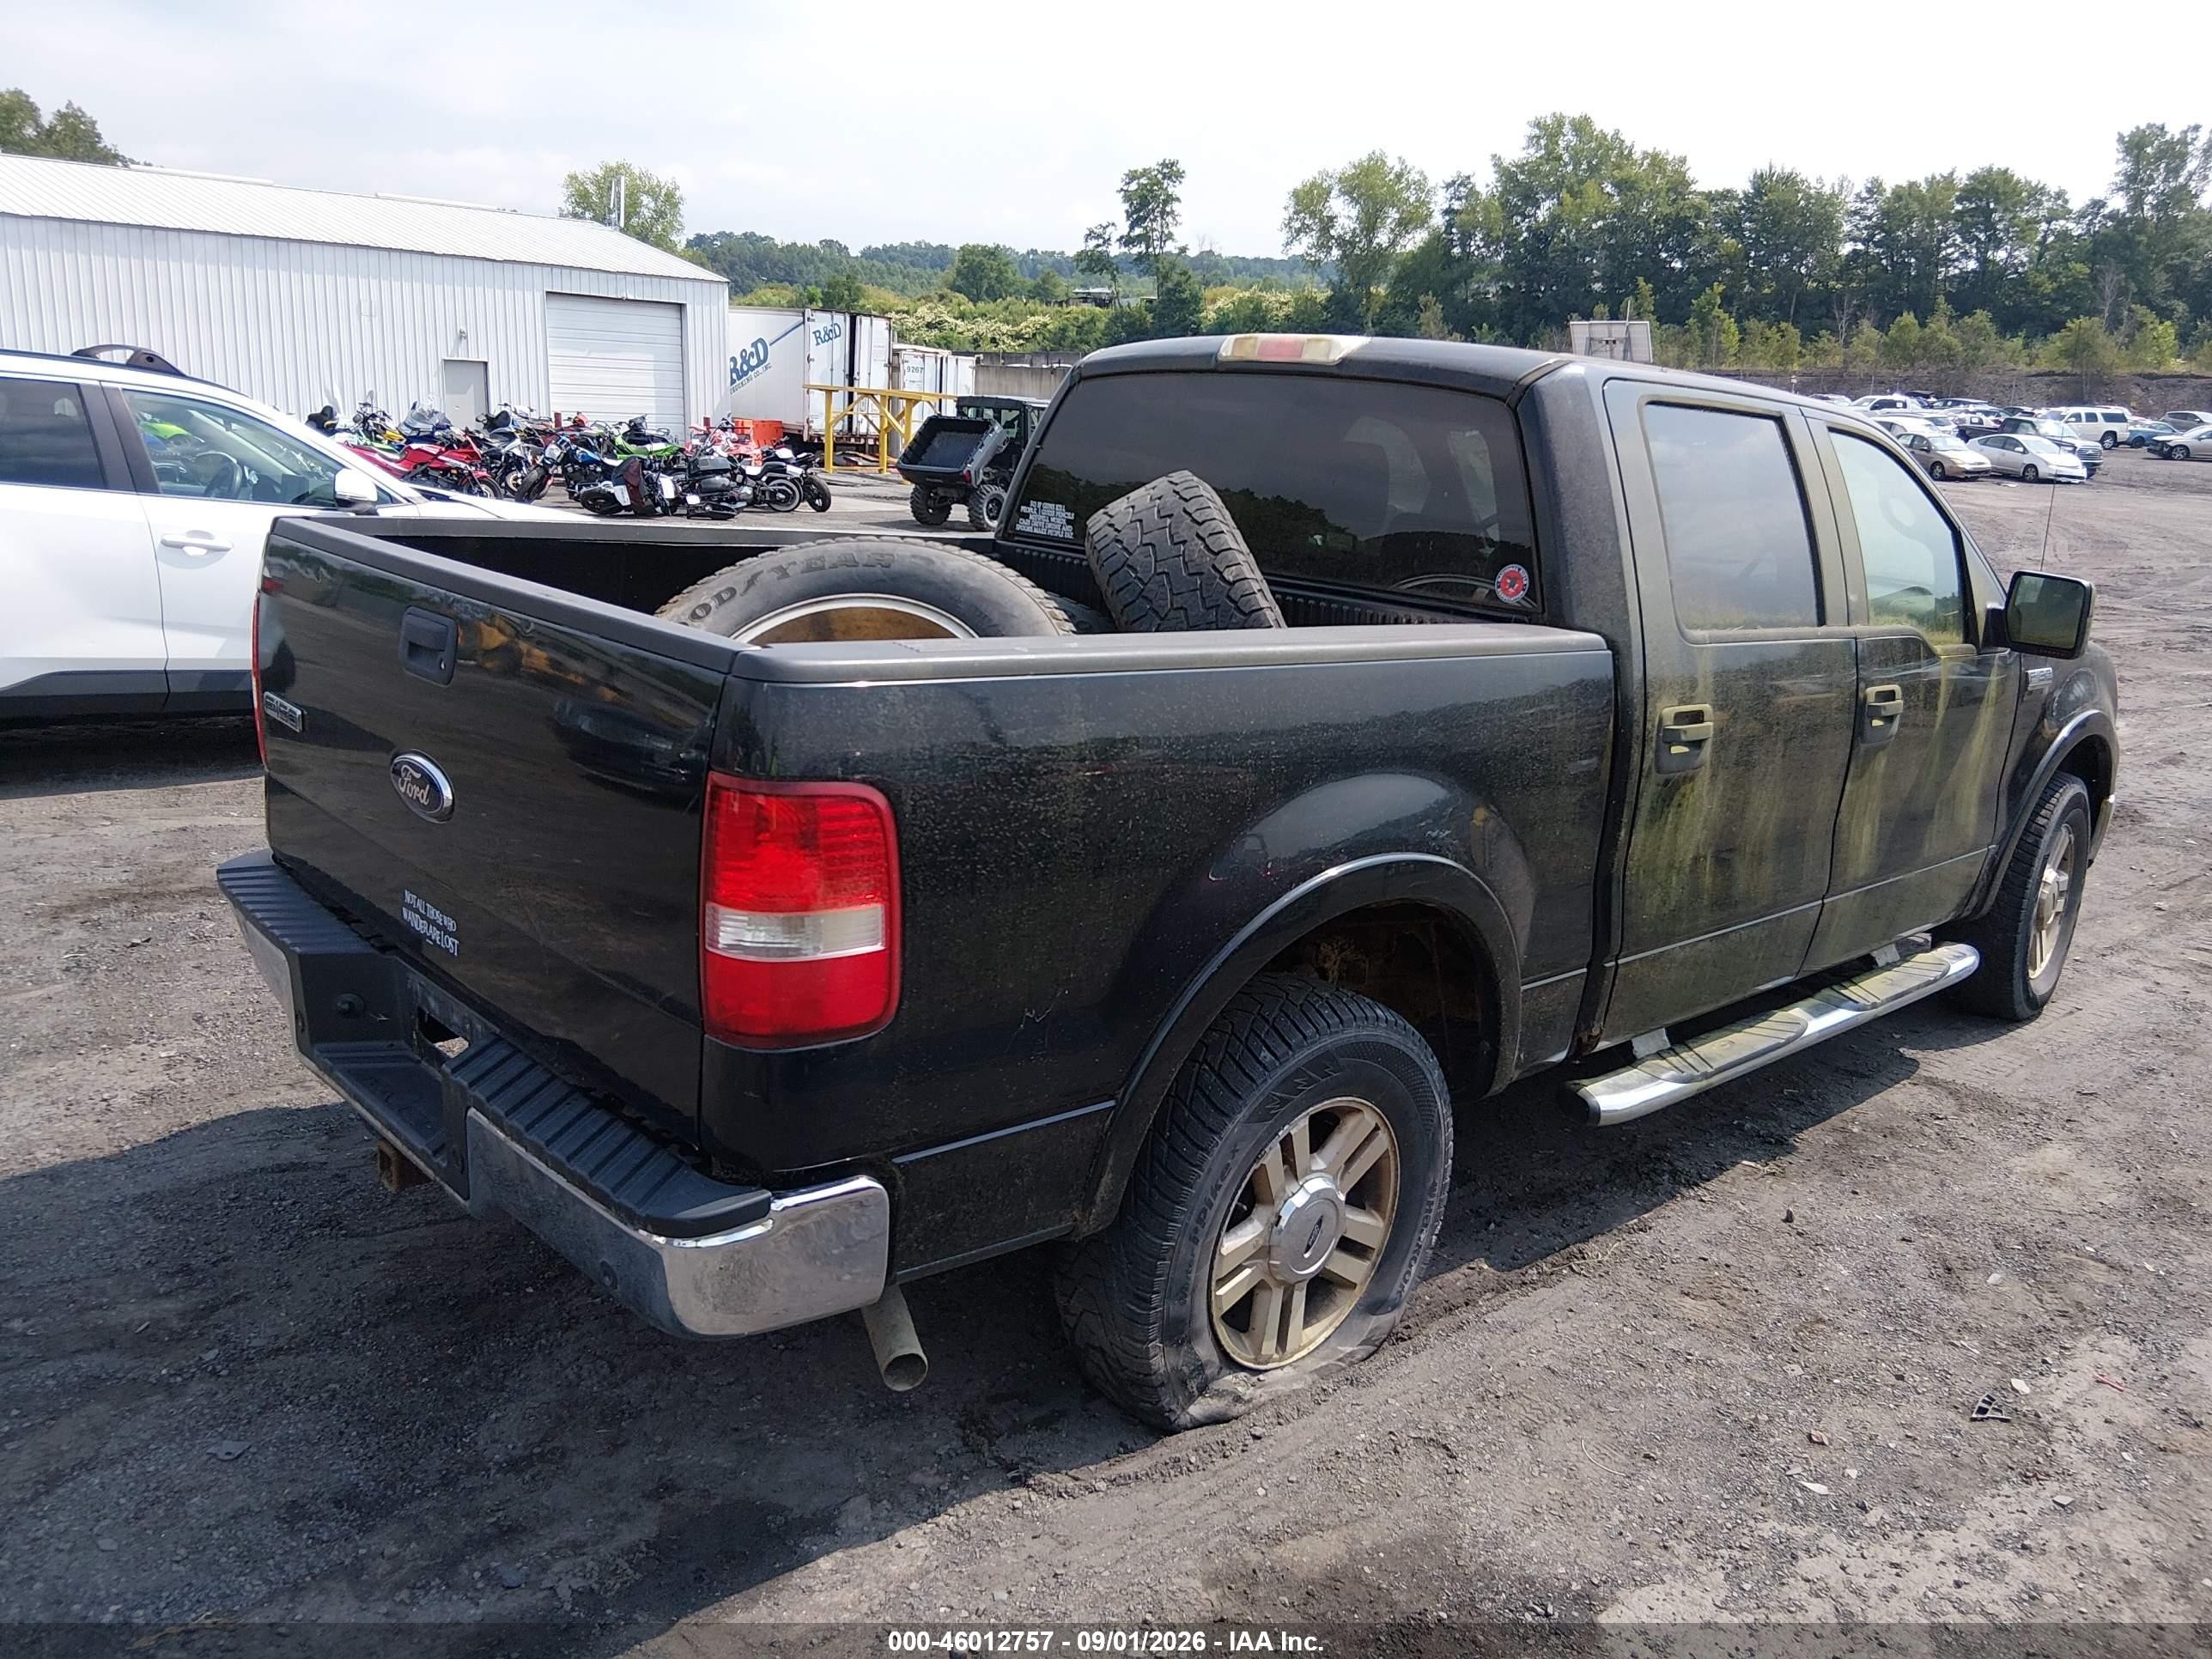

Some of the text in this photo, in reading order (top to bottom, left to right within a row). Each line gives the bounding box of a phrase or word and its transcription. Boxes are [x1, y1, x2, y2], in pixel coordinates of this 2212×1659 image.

[812, 323, 842, 346] R&D
[729, 337, 769, 386] R&D
[906, 366, 925, 374] 9267
[398, 764, 430, 805] Ford
[404, 890, 457, 932] NOT ALL THOSE WHO
[402, 907, 460, 957] WANDER ARE LOST
